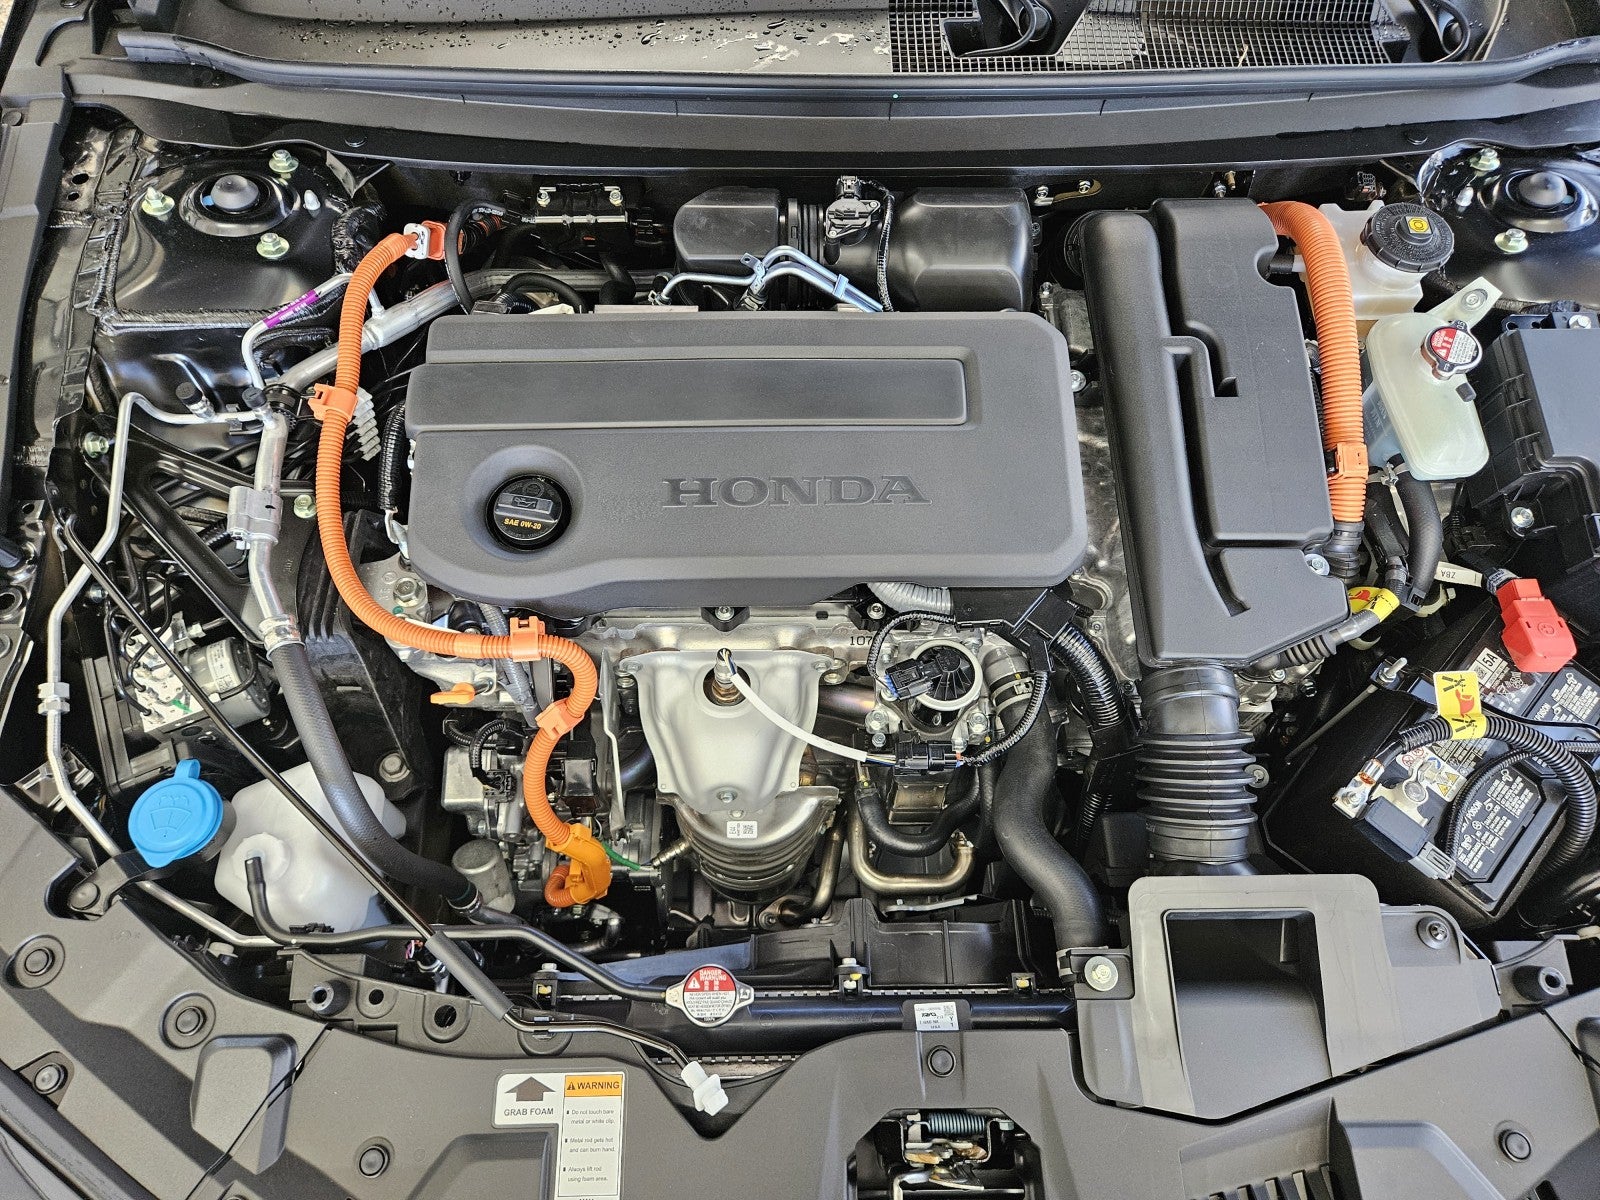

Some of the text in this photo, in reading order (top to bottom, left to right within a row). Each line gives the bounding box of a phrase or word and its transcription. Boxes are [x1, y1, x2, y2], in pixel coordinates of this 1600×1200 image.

[662, 475, 933, 508] HONDA
[503, 518, 541, 530] SAE 0W-20
[850, 635, 873, 646] 107
[577, 1082, 620, 1090] WARNING
[504, 1108, 554, 1116] GRAB FOAM
